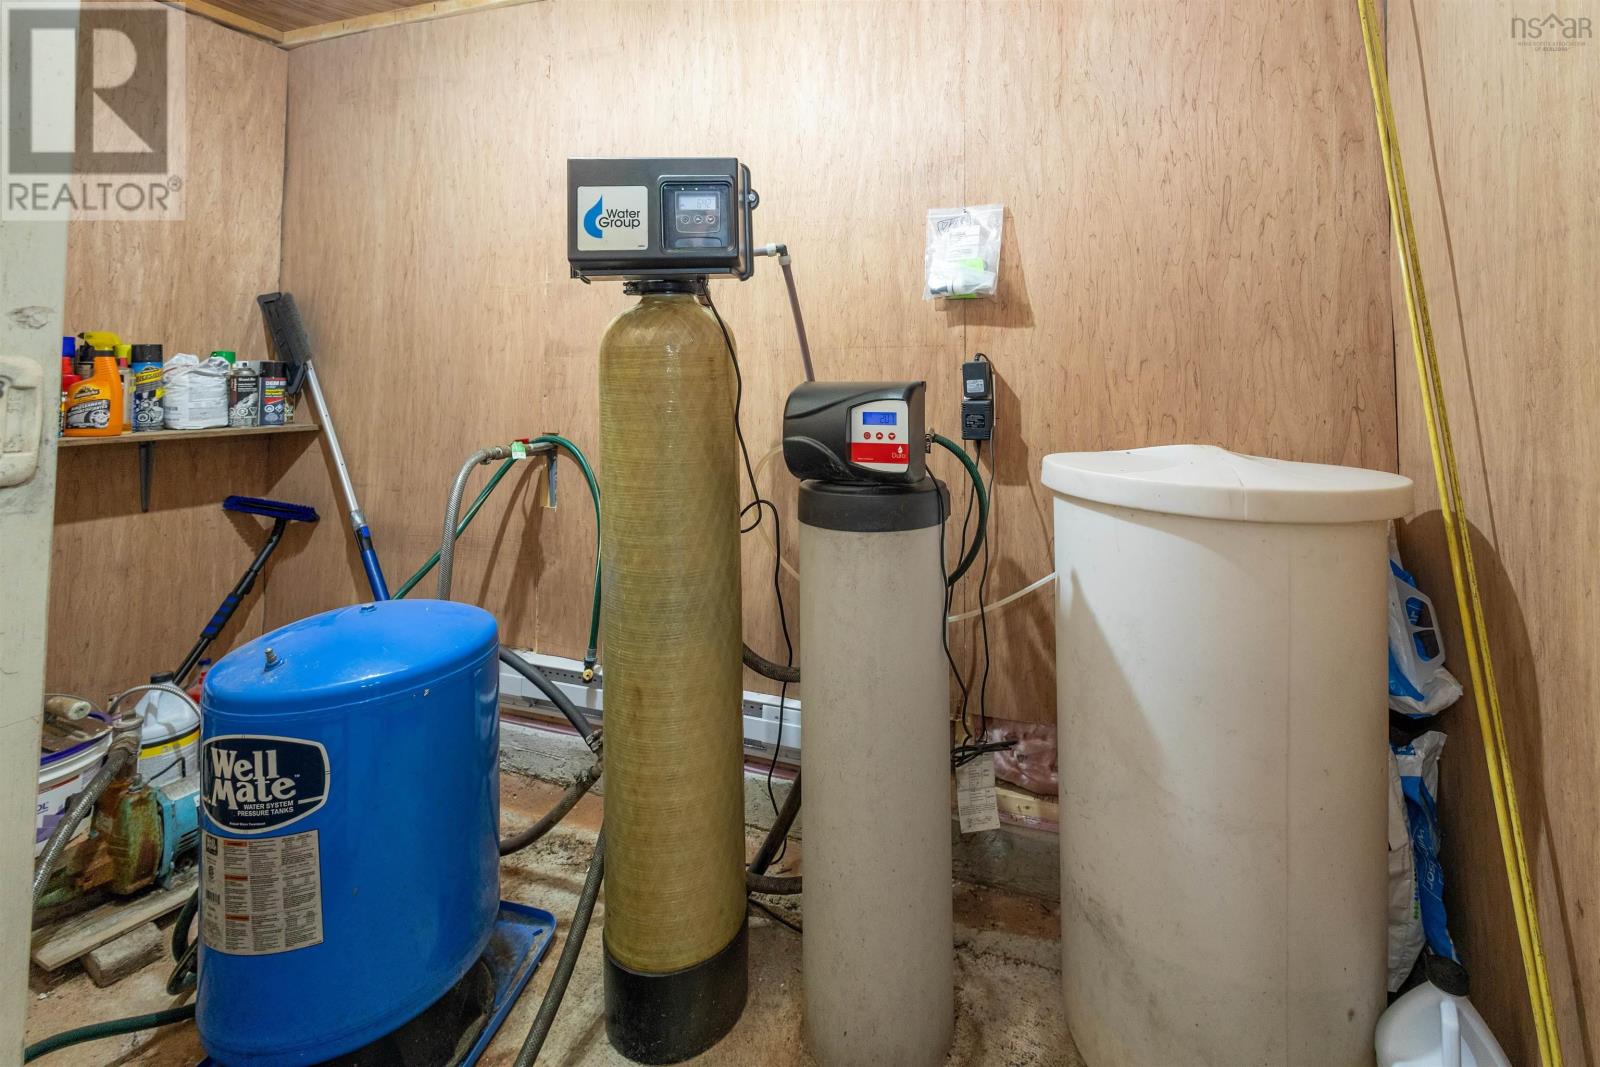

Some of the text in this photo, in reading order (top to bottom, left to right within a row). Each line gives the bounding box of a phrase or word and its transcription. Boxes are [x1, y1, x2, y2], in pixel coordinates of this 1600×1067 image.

[606, 208, 641, 219] Water
[598, 216, 641, 229] Group
[210, 747, 280, 782] Well
[211, 777, 297, 810] Mate
[266, 800, 294, 809] SYSTEM
[237, 806, 294, 817] PRESSURE TANKS
